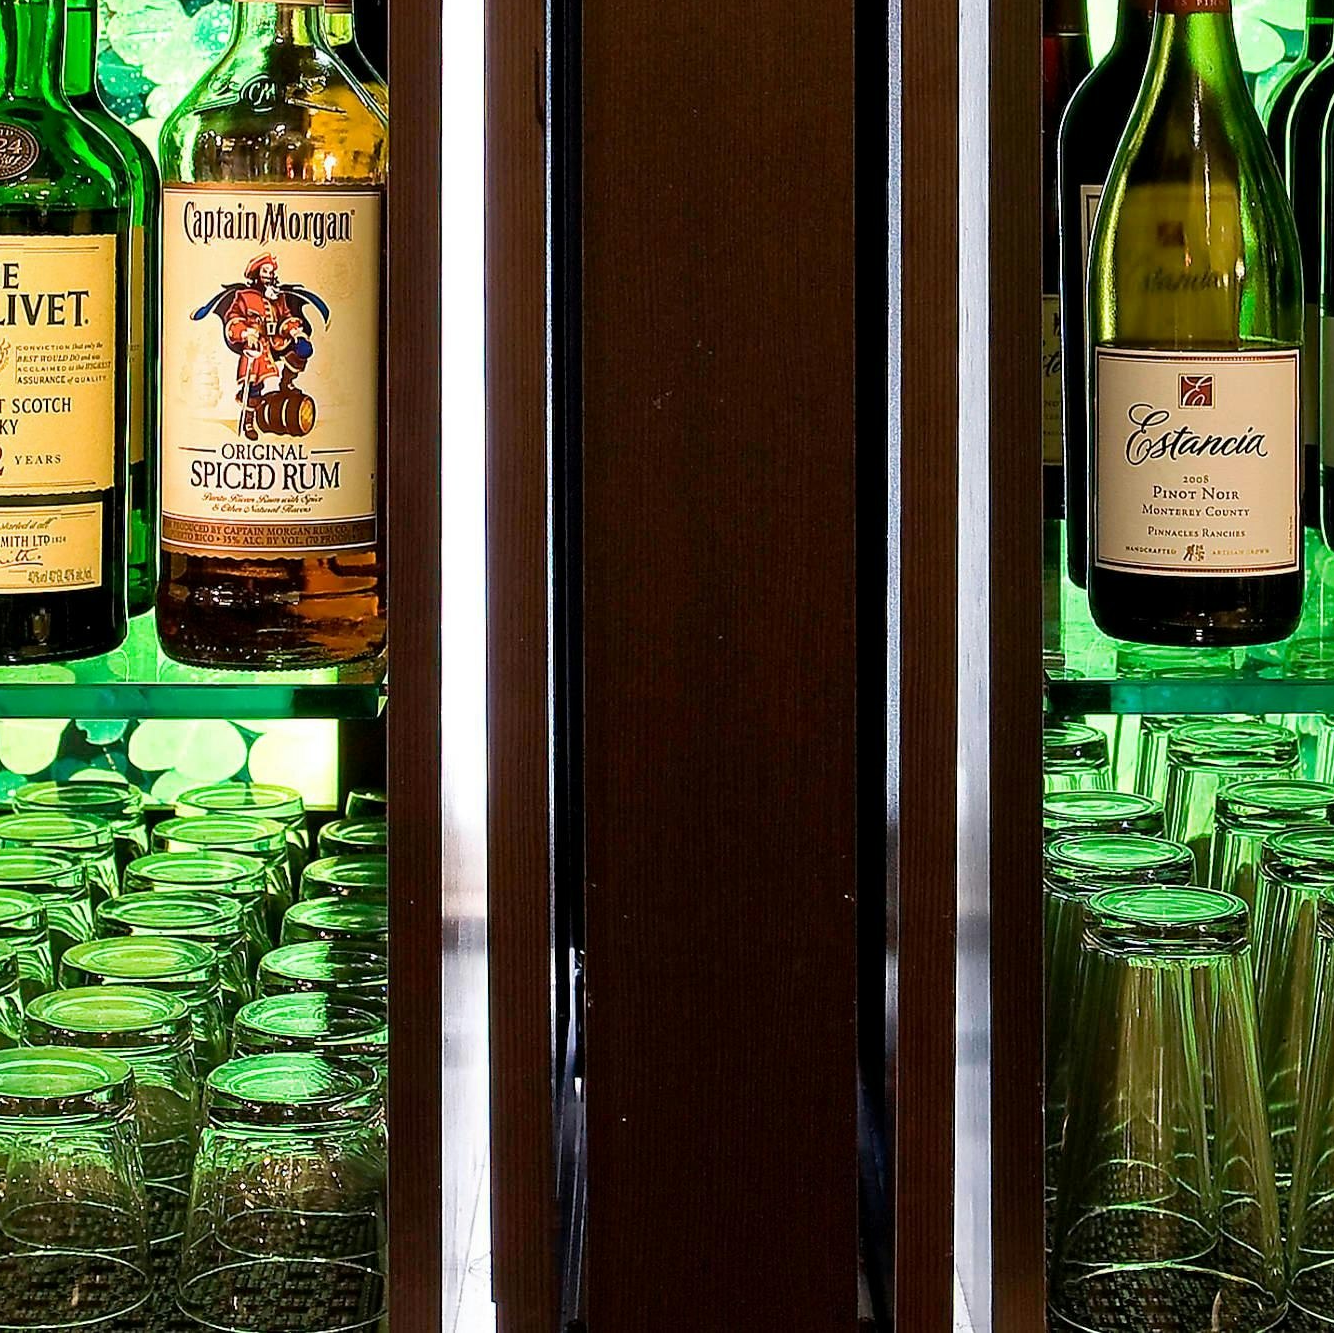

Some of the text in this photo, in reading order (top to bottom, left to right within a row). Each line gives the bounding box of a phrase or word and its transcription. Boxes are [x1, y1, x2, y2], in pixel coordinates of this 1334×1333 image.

[183, 201, 352, 248] Captain Morgan
[12, 395, 72, 413] SCOTCH
[1125, 403, 1268, 466] Estancia
[14, 454, 62, 465] YEARS
[221, 443, 308, 460] ORIGINAL
[191, 460, 340, 494] SPICED RUM
[1183, 475, 1209, 484] 2008
[1153, 486, 1240, 501] PINOT NOIR
[1142, 503, 1250, 517] MONTEREY COUNTY
[1147, 525, 1199, 538] PINNACLES
